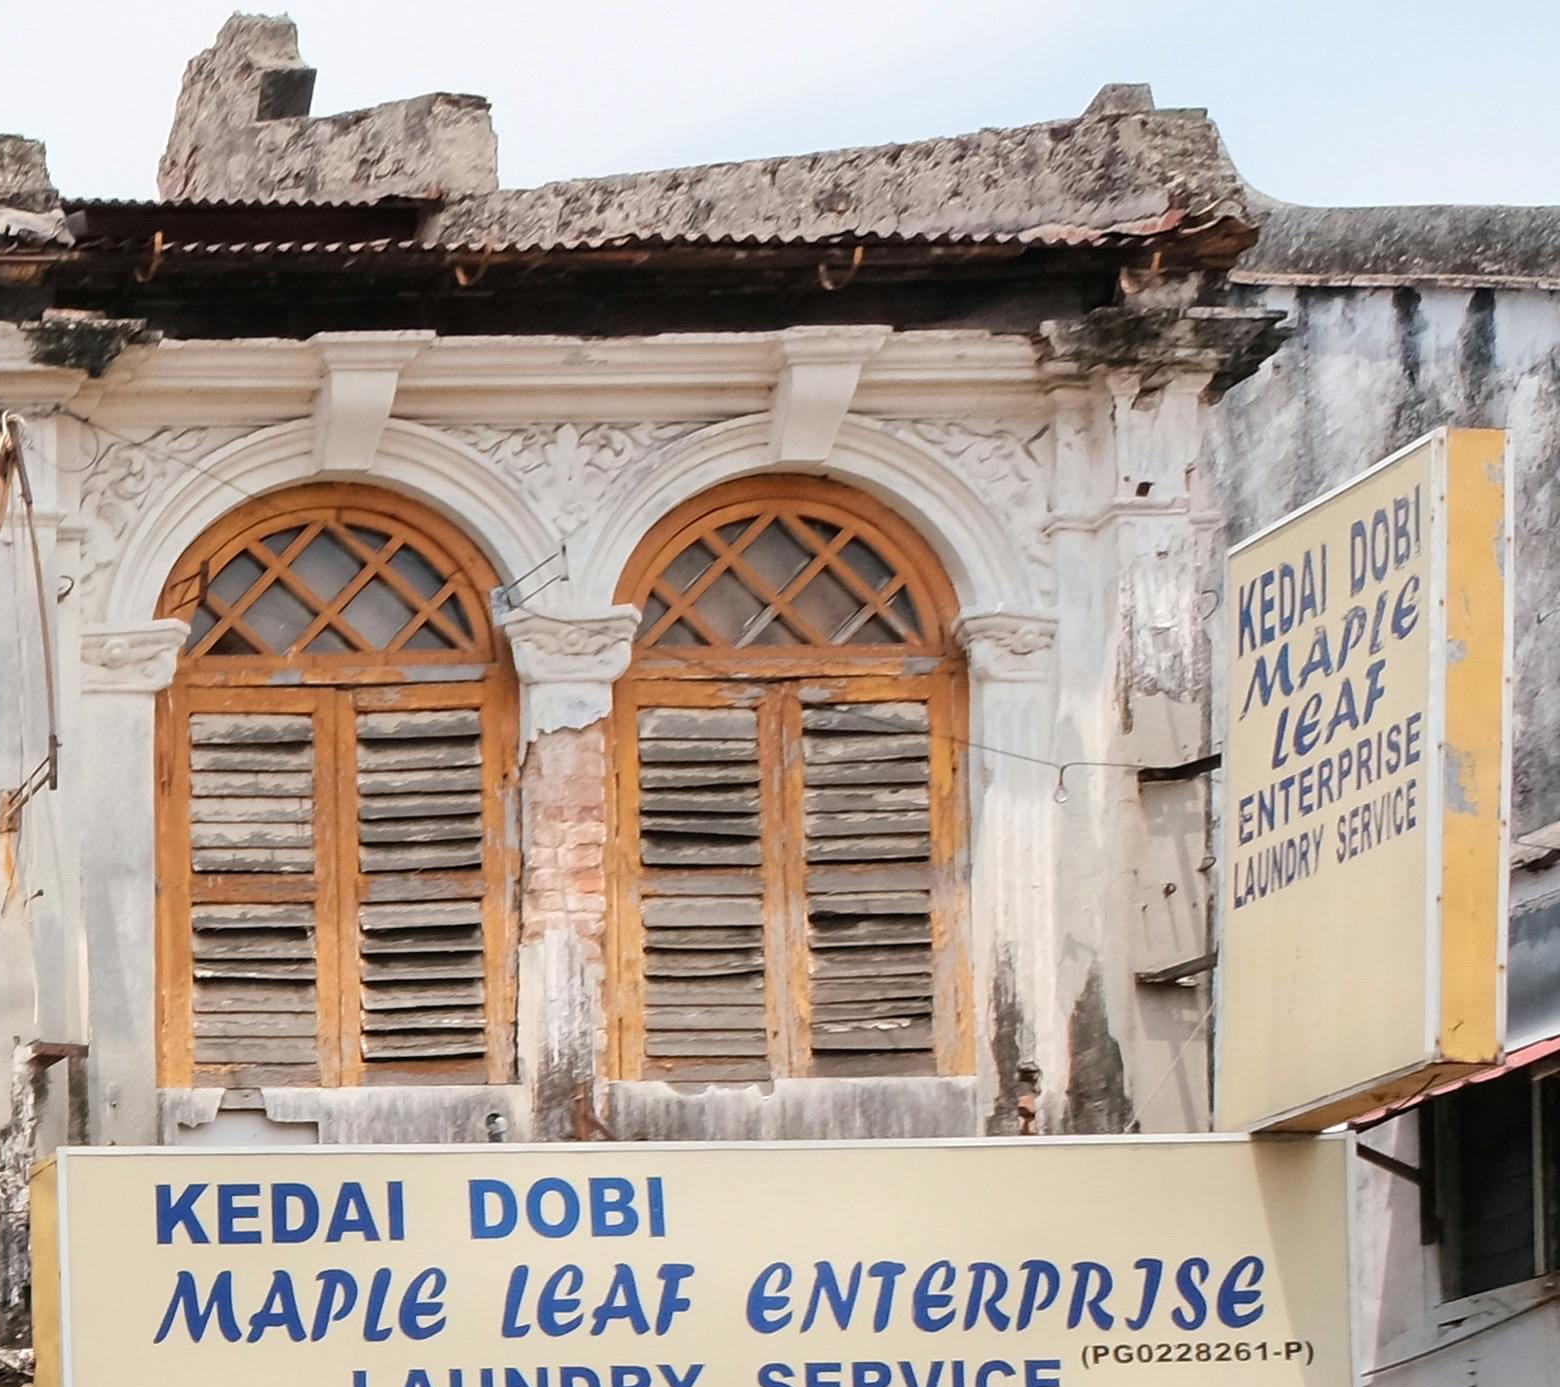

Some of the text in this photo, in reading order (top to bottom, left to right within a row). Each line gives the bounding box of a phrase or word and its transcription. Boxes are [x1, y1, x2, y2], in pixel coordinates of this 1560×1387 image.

[1238, 485, 1421, 659] KEDAI DOBI
[1238, 575, 1419, 721] MAPLE
[1272, 659, 1386, 770] LEAF
[1238, 712, 1422, 847] ENTERPRISE
[1233, 779, 1417, 910] LAUNDRY SERVICE
[156, 1177, 665, 1244] KEDAI DOBI
[154, 1256, 1264, 1343] MAPLE LEAF ENTERPRISE
[1082, 1341, 1314, 1369] (PG0228261-P)
